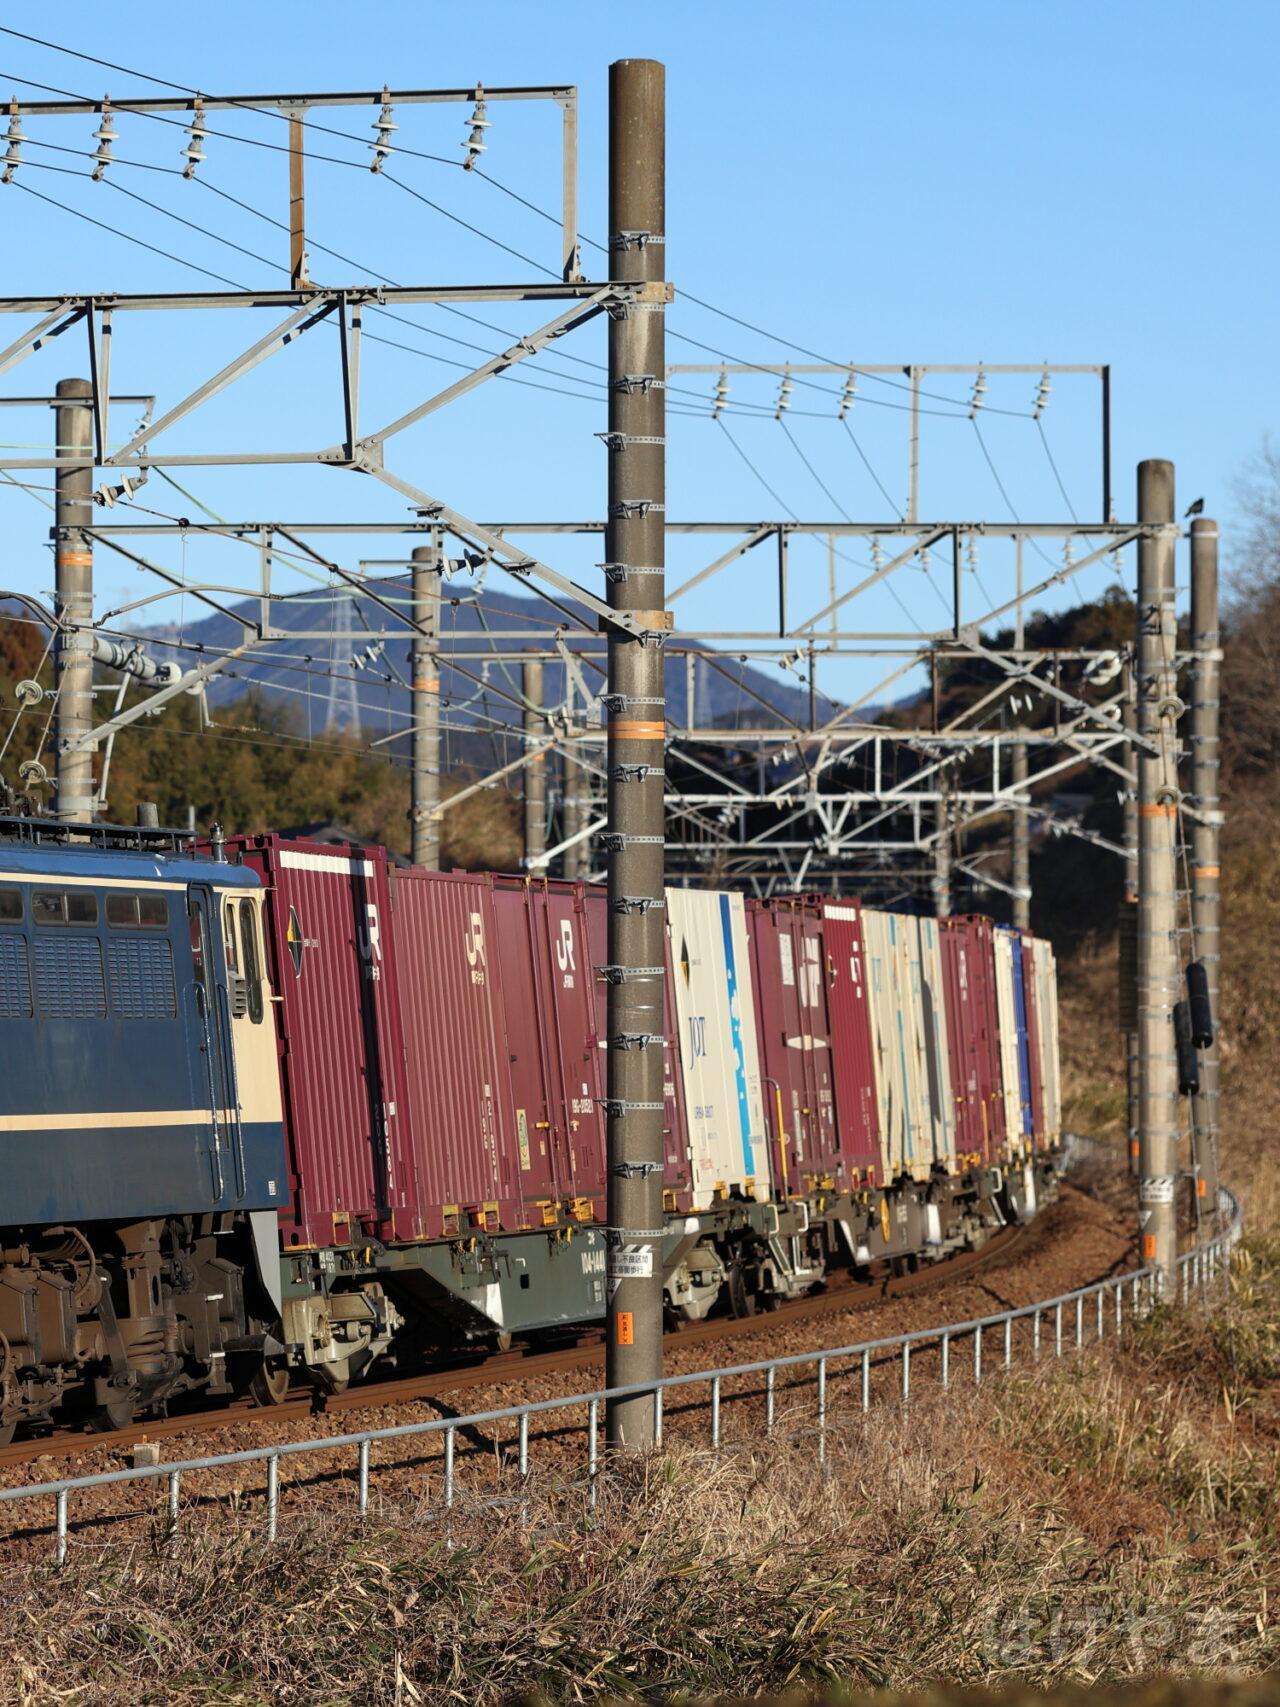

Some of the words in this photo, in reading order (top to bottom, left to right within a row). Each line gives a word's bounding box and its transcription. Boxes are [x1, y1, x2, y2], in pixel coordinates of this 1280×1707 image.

[465, 913, 486, 967] JR
[556, 919, 576, 971] JR
[689, 1016, 706, 1070] JOT
